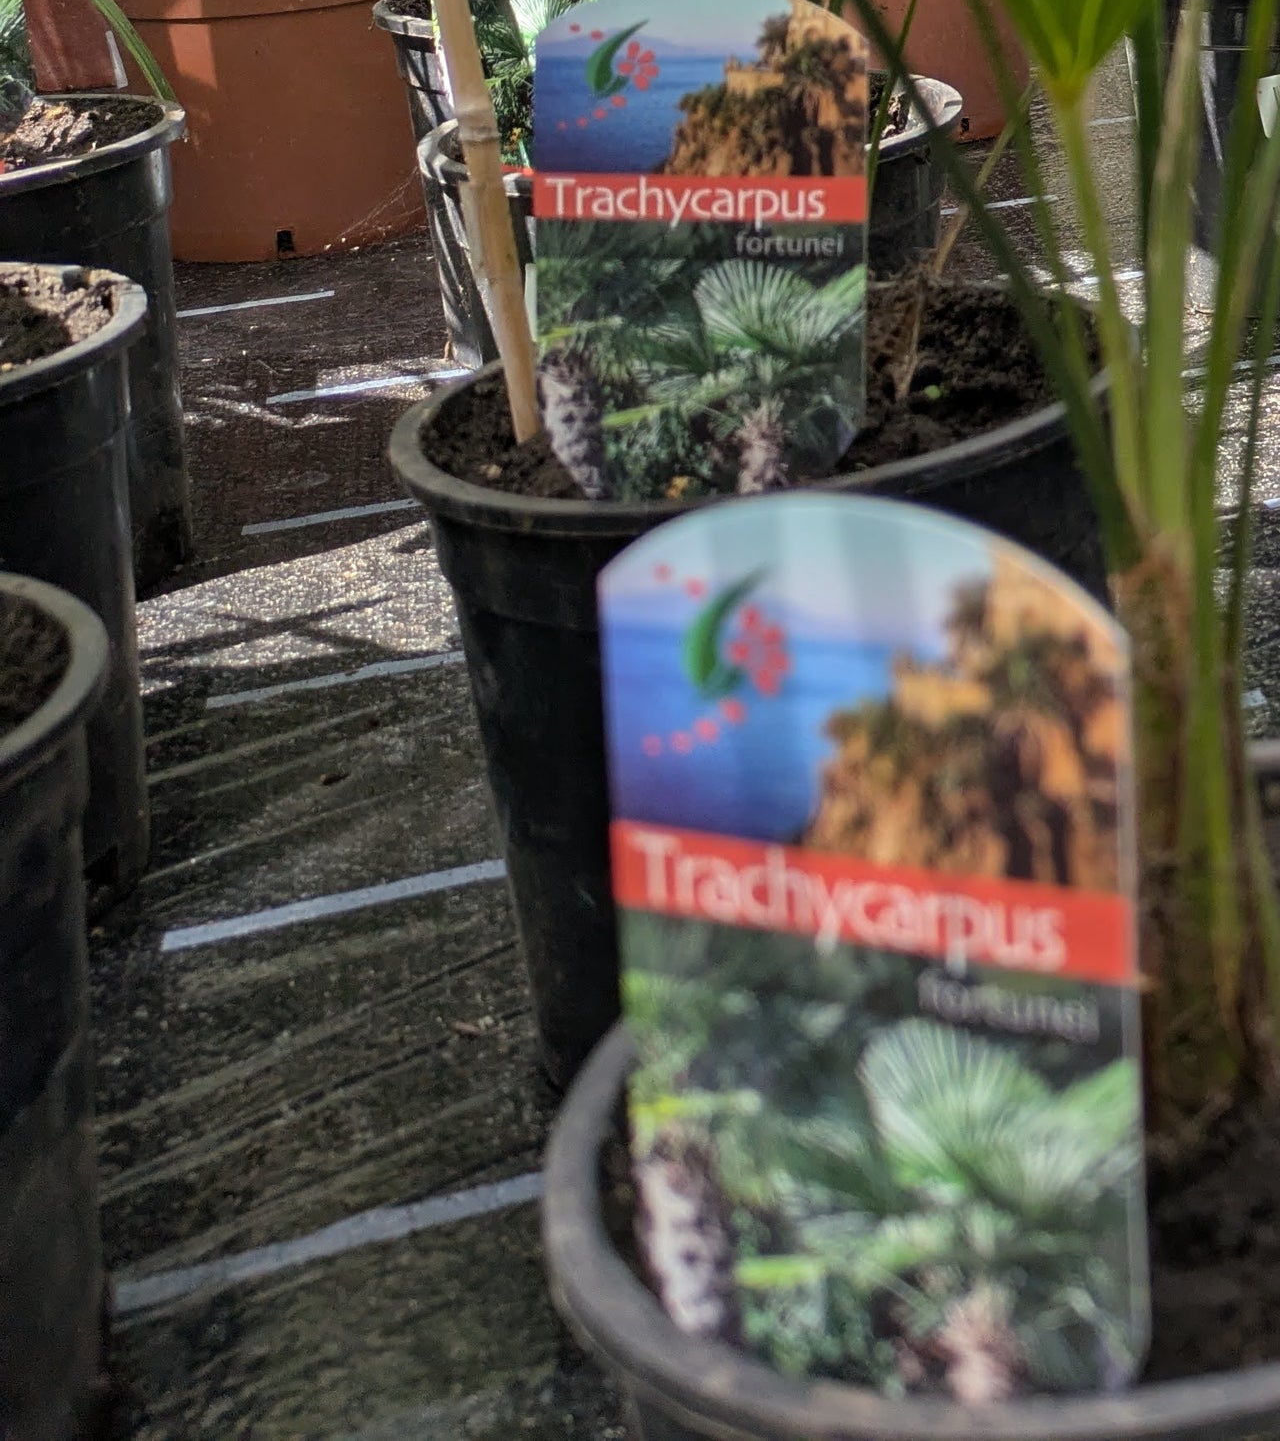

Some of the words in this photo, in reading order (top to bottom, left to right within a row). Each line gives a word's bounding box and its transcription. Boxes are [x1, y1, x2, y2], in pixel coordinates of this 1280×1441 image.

[545, 175, 826, 230] Trachycarpus
[735, 233, 845, 258] fortunei
[628, 830, 1068, 979] Trachycarpus
